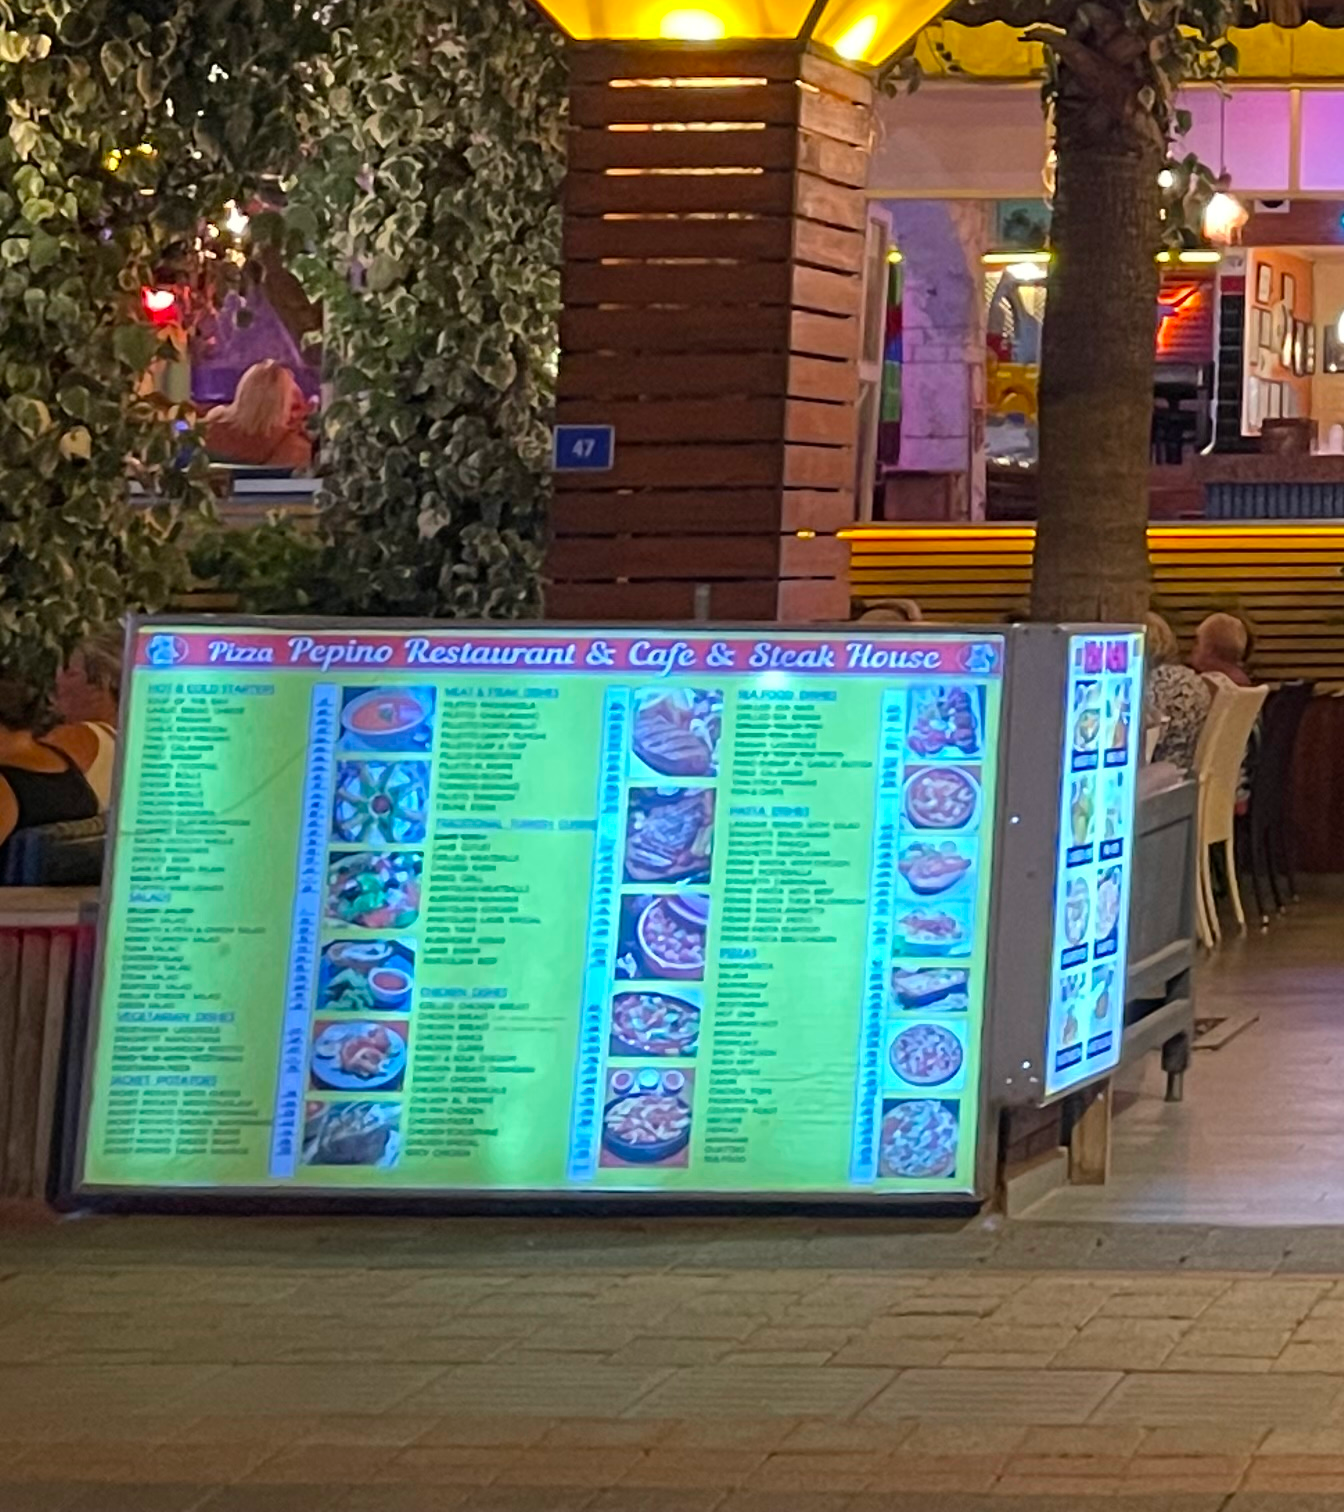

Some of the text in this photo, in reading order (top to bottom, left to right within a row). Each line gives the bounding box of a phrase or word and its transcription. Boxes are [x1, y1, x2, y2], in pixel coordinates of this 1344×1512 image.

[572, 438, 596, 457] 47
[207, 637, 943, 679] Pizza Pepino Restaurant & Cafe & Steak House
